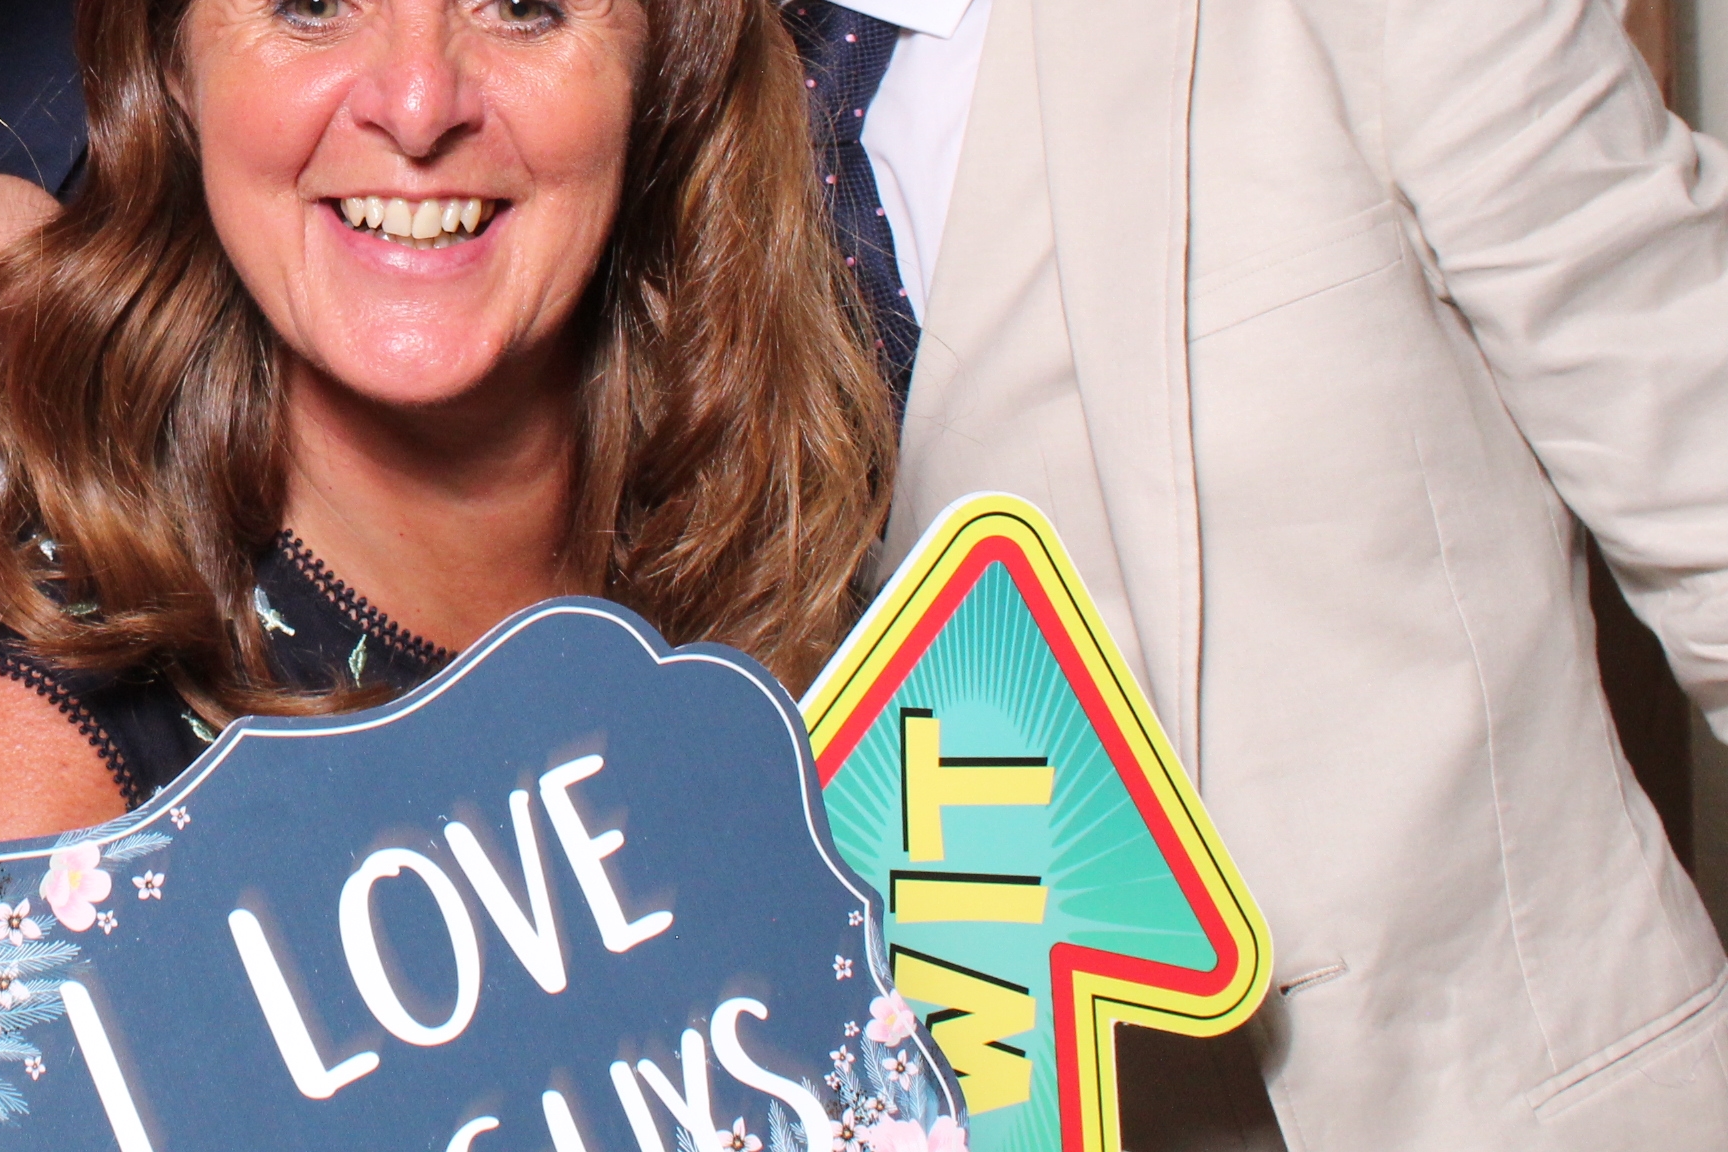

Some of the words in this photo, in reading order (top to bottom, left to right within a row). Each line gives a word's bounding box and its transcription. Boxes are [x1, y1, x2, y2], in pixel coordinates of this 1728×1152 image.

[60, 980, 153, 1152] I
[228, 754, 673, 1100] LOVE
[444, 997, 835, 1152] YS
